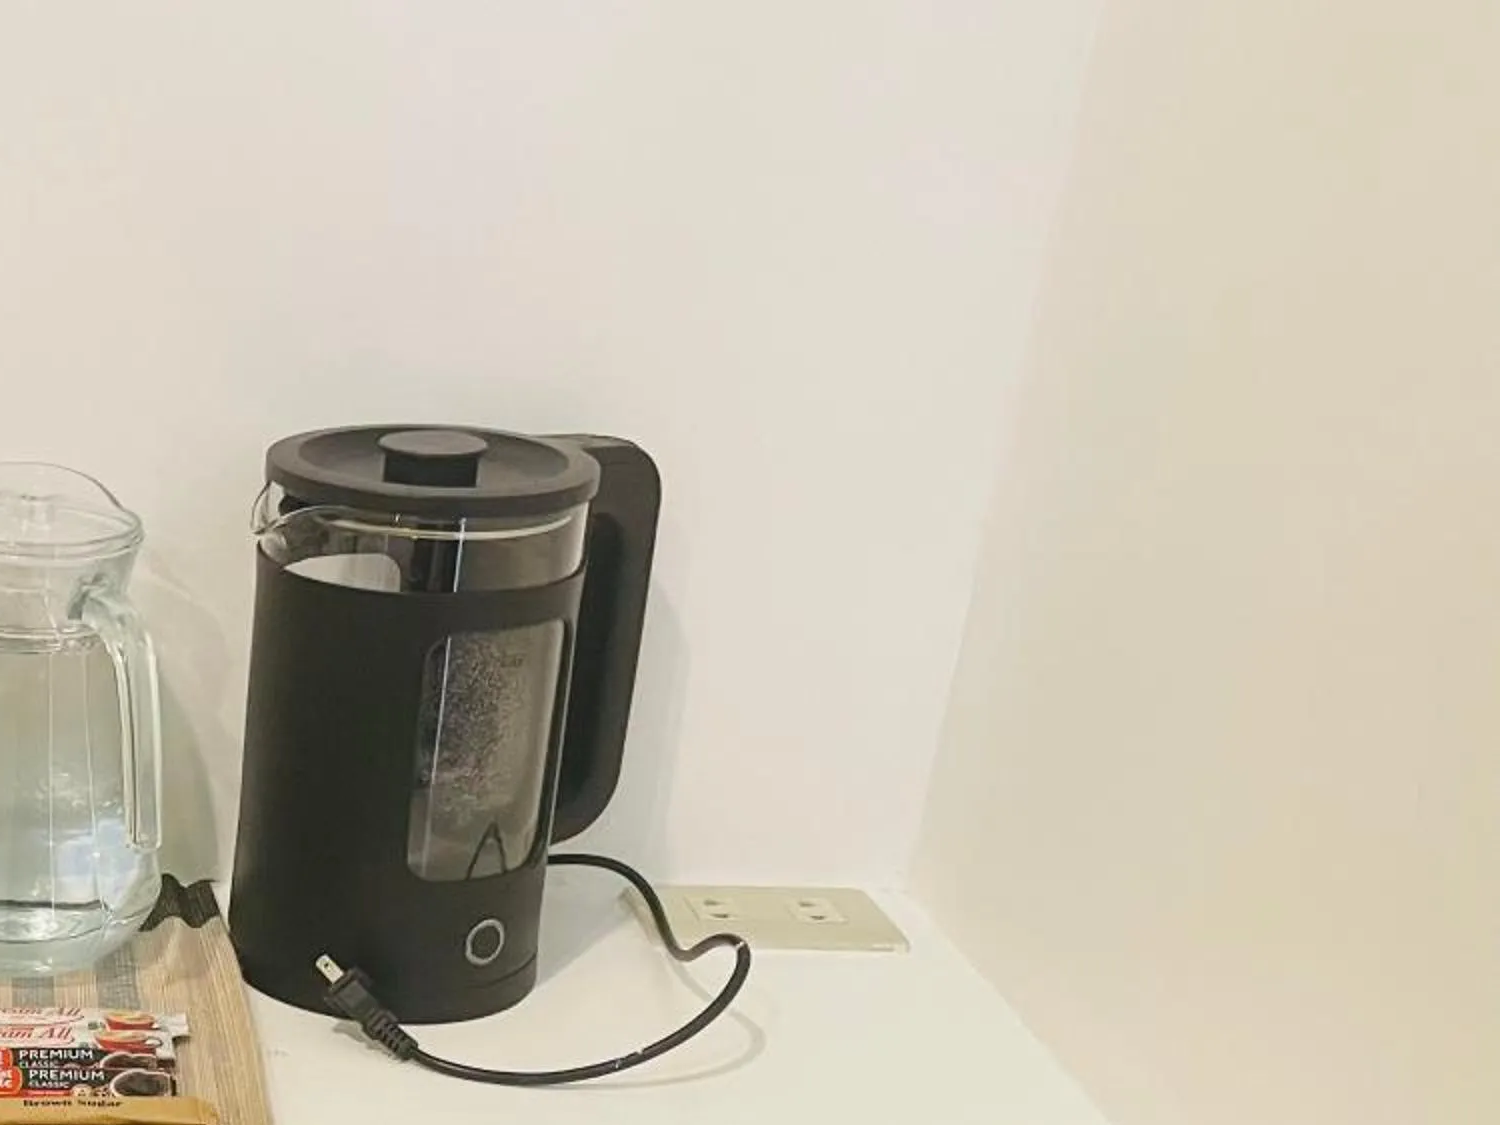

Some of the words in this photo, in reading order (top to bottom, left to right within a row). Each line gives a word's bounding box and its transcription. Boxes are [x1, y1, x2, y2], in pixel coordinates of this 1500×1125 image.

[38, 1026, 74, 1040] All
[19, 1050, 93, 1059] PREMIUM
[19, 1060, 59, 1069] CLASSIC
[28, 1069, 105, 1081] PREMIUM
